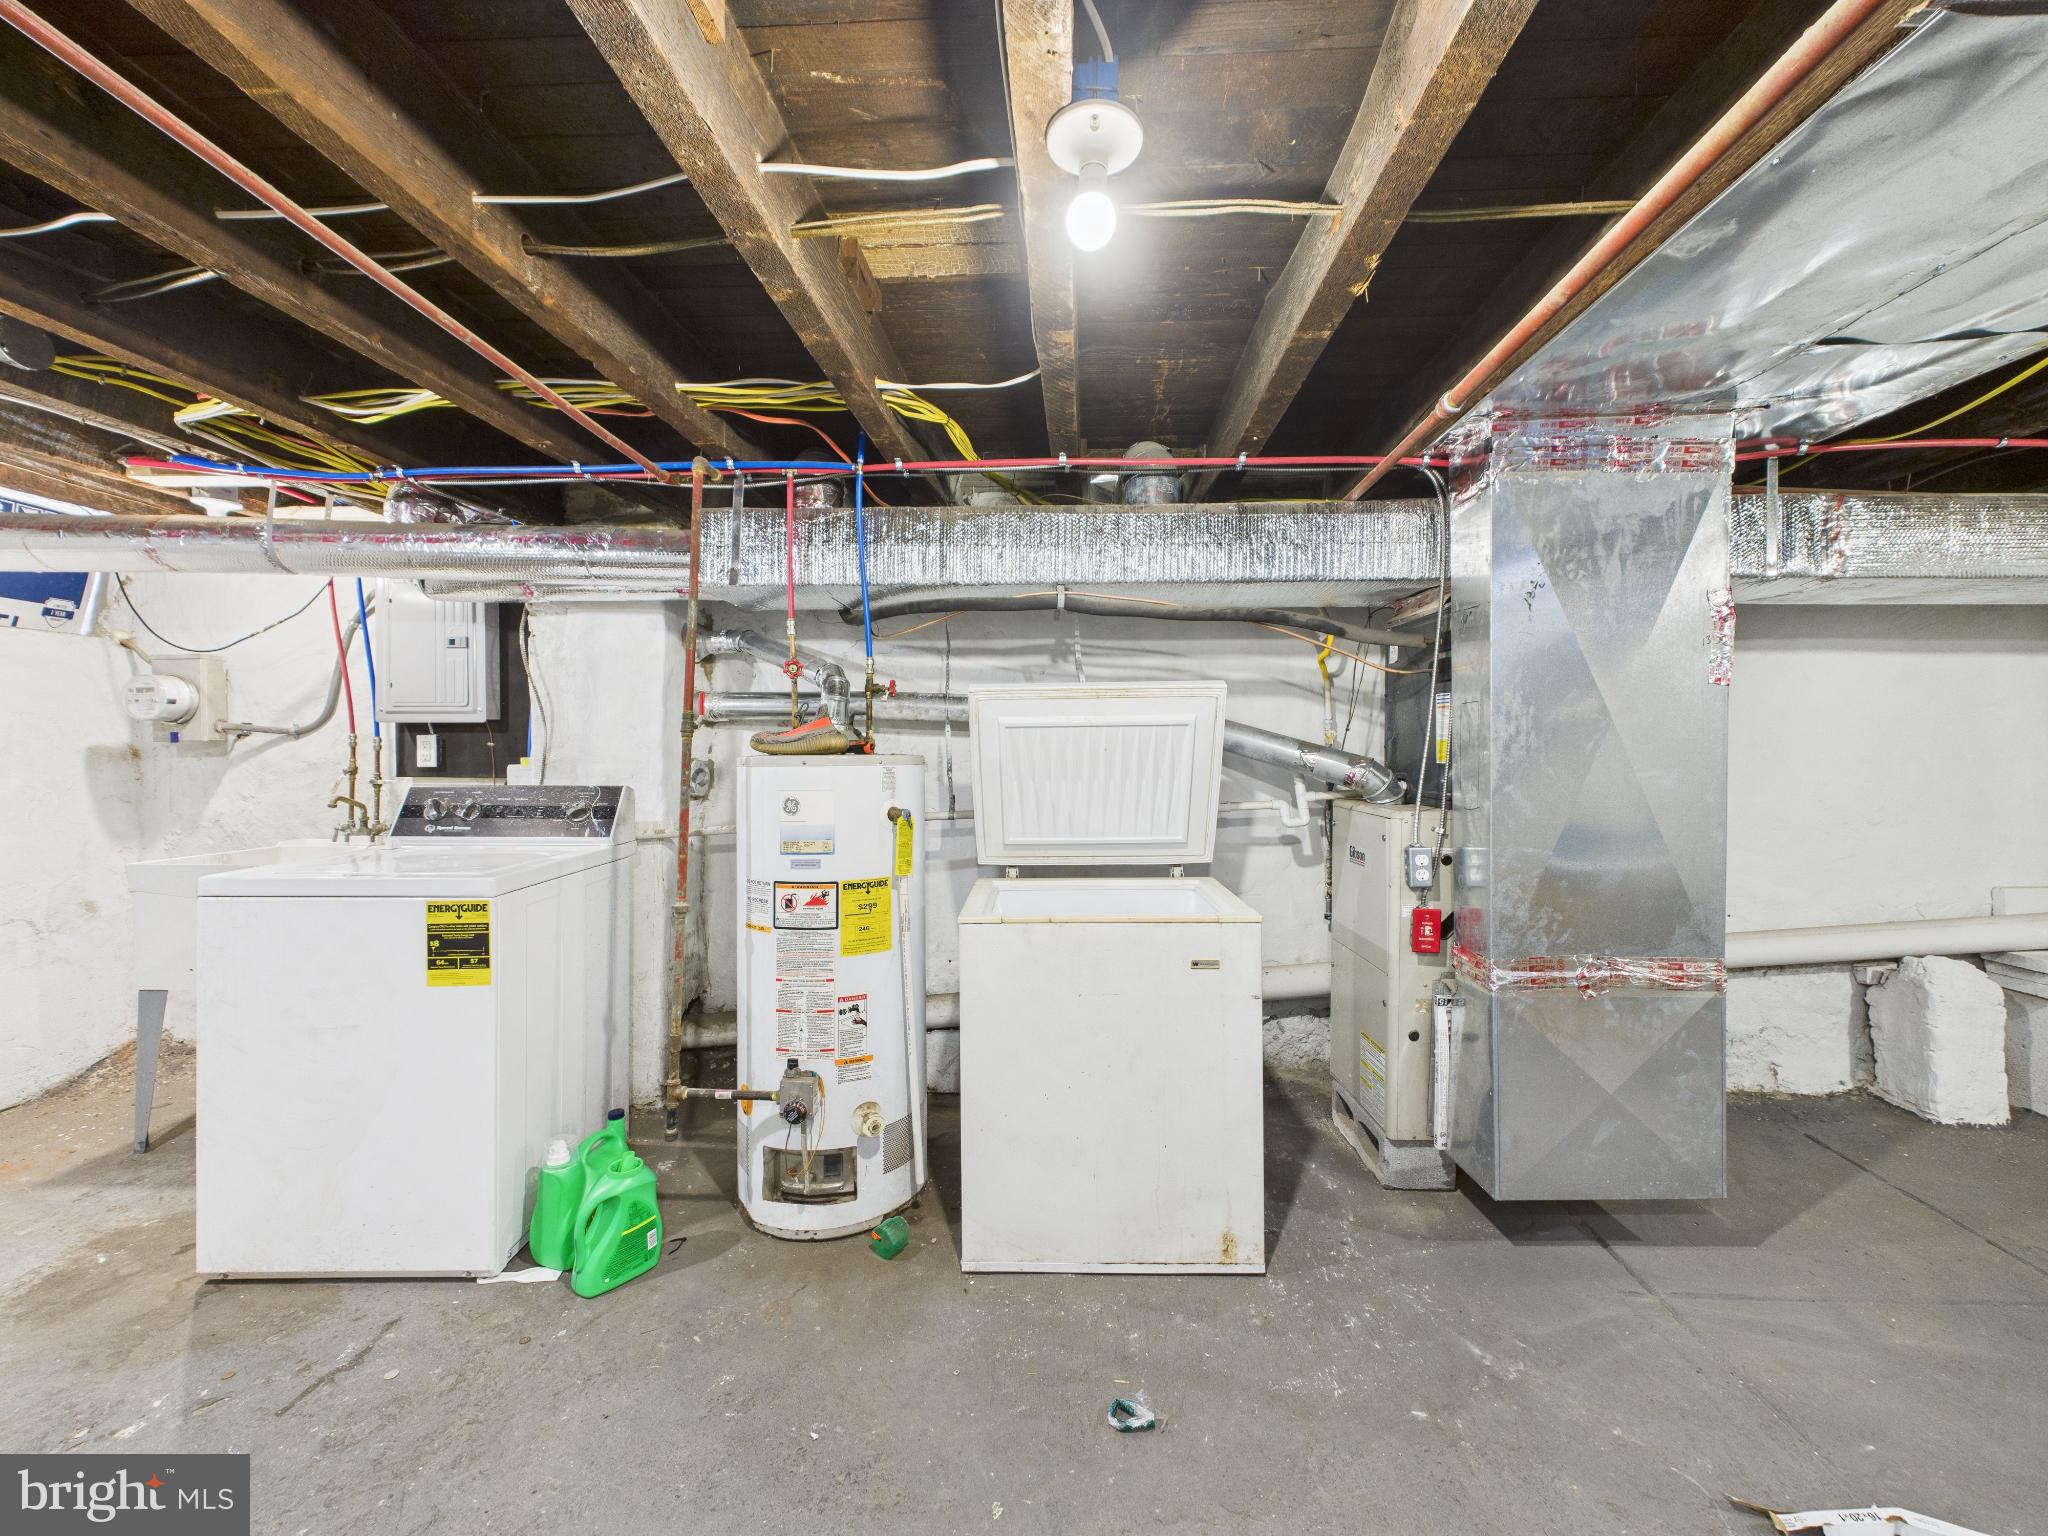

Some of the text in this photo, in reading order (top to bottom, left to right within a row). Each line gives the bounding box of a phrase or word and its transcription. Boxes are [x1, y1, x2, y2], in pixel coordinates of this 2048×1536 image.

[842, 879, 889, 891] ENERGYGUIDE
[427, 903, 488, 914] ENERGYGUIDE
[857, 902, 878, 910] $299
